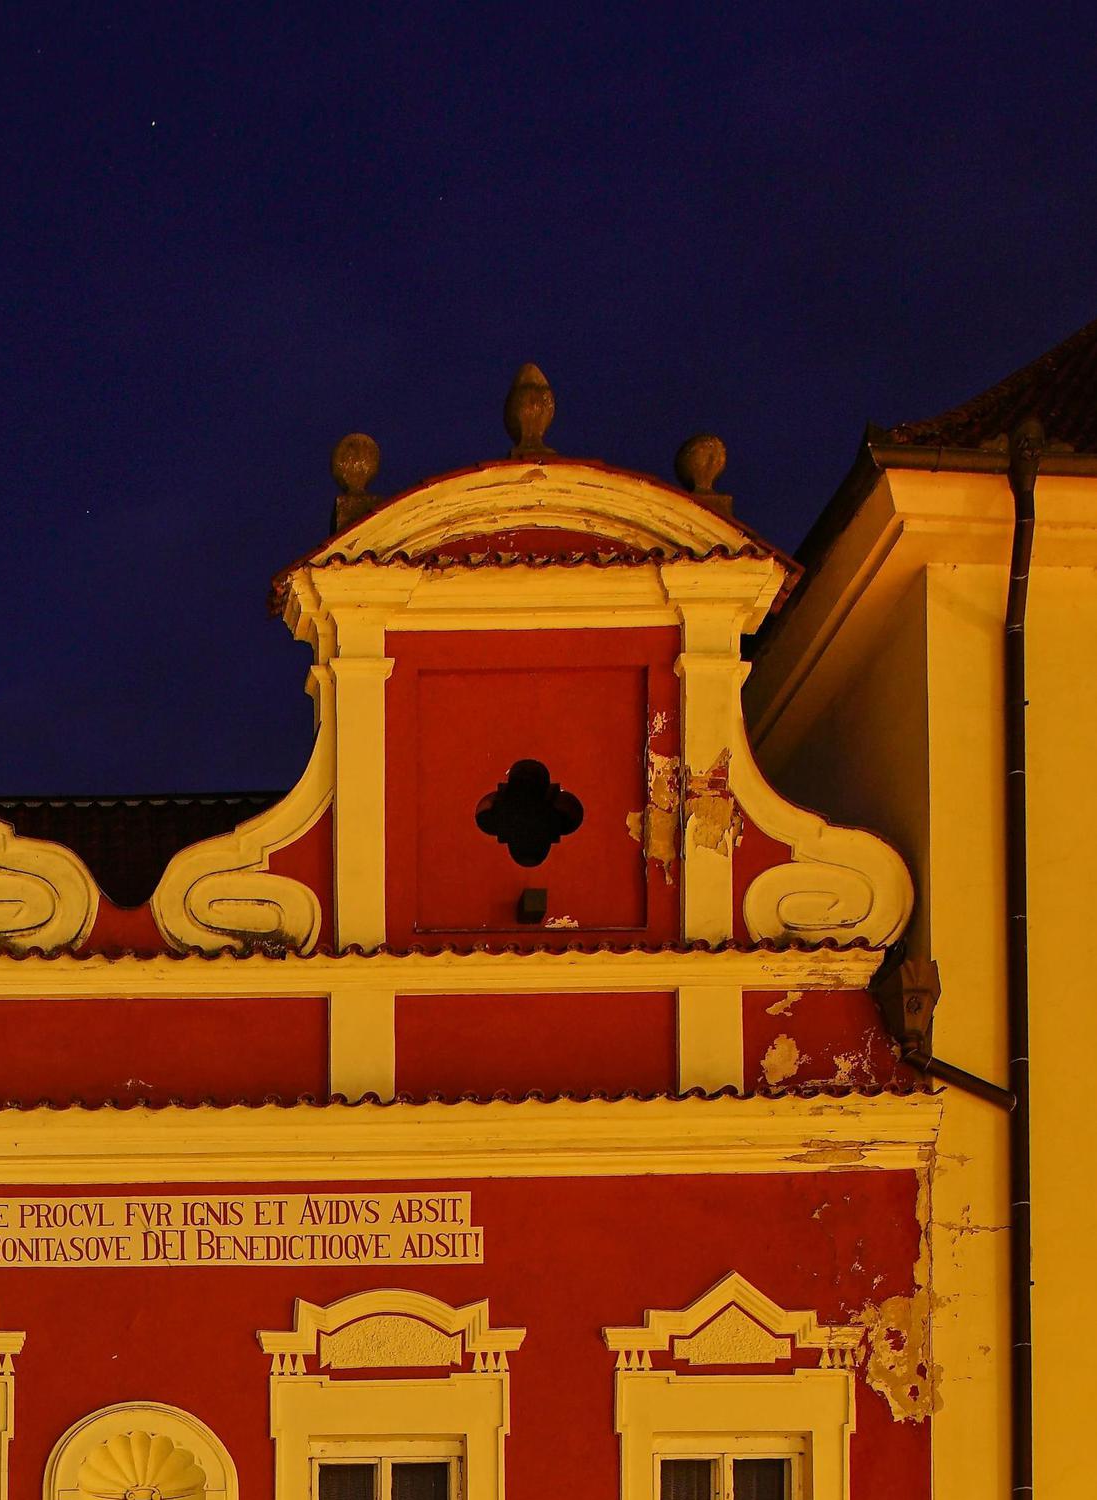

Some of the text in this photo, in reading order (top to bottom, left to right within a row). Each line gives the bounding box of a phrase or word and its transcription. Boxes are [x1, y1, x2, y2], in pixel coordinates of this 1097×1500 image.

[20, 1202, 115, 1229] PROCVL
[125, 1201, 173, 1227] FVR
[182, 1200, 245, 1227] IGNIS
[254, 1200, 288, 1226] ET
[300, 1194, 380, 1226] AVIDVS
[390, 1198, 464, 1226] ABSIT,
[140, 1230, 187, 1262] DEI
[195, 1230, 391, 1263] BENEDICTIOQVE
[400, 1232, 480, 1260] ADSIT!
